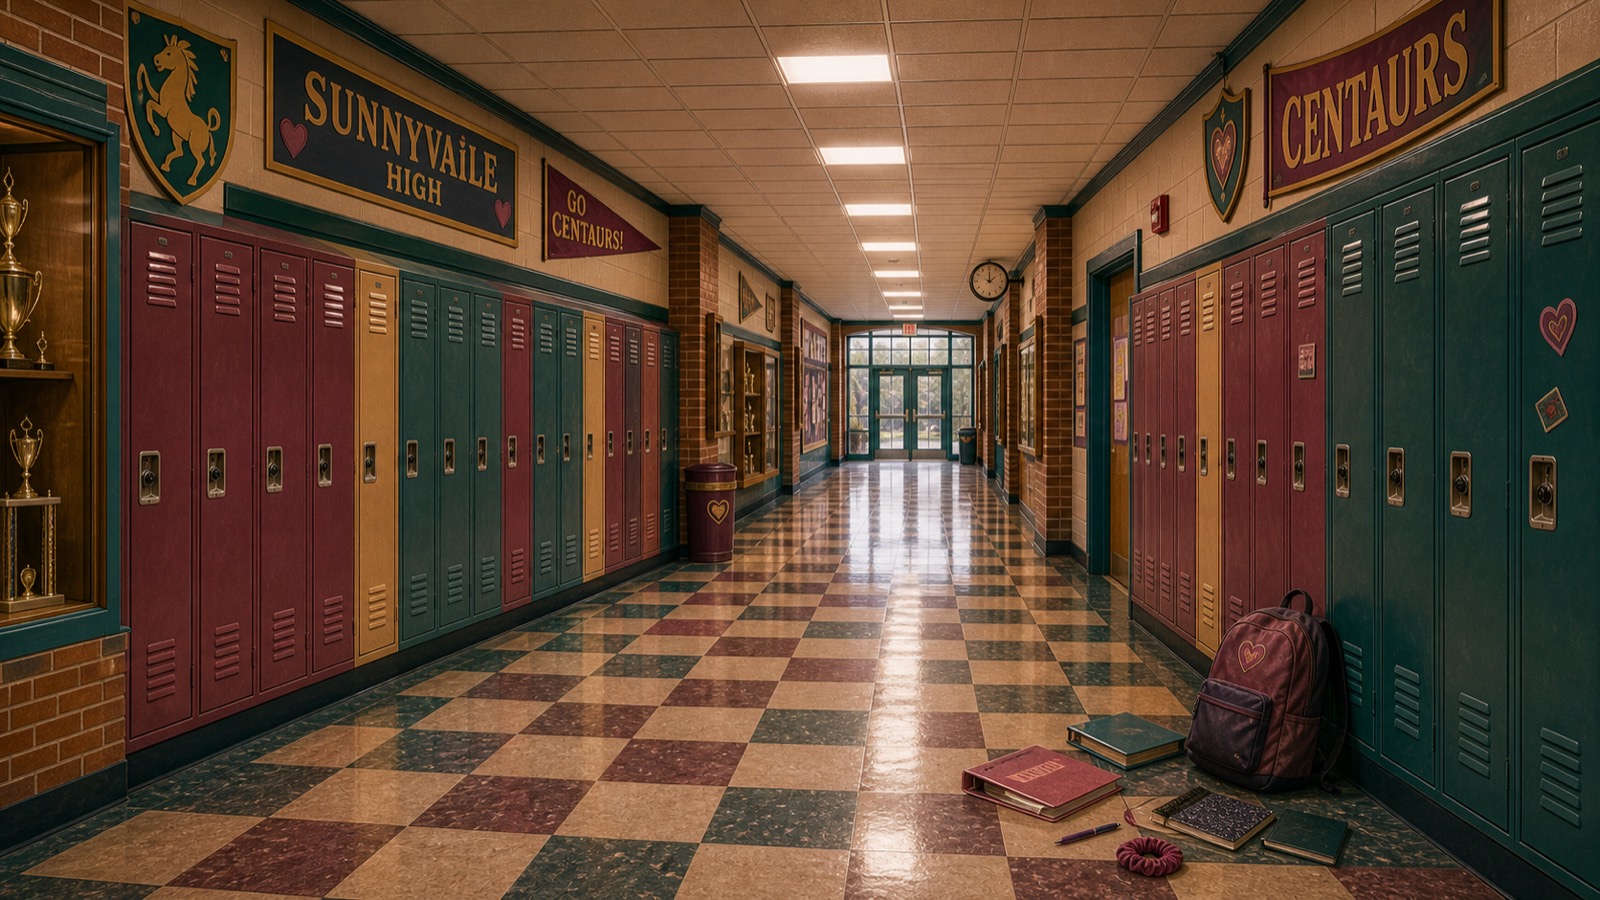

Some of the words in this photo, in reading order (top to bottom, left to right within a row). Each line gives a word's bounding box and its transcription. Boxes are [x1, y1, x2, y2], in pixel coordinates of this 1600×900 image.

[1281, 8, 1469, 170] CENTAURS
[386, 161, 442, 207] HIGH
[567, 189, 587, 217] GO
[551, 210, 624, 251] CENTAURS!
